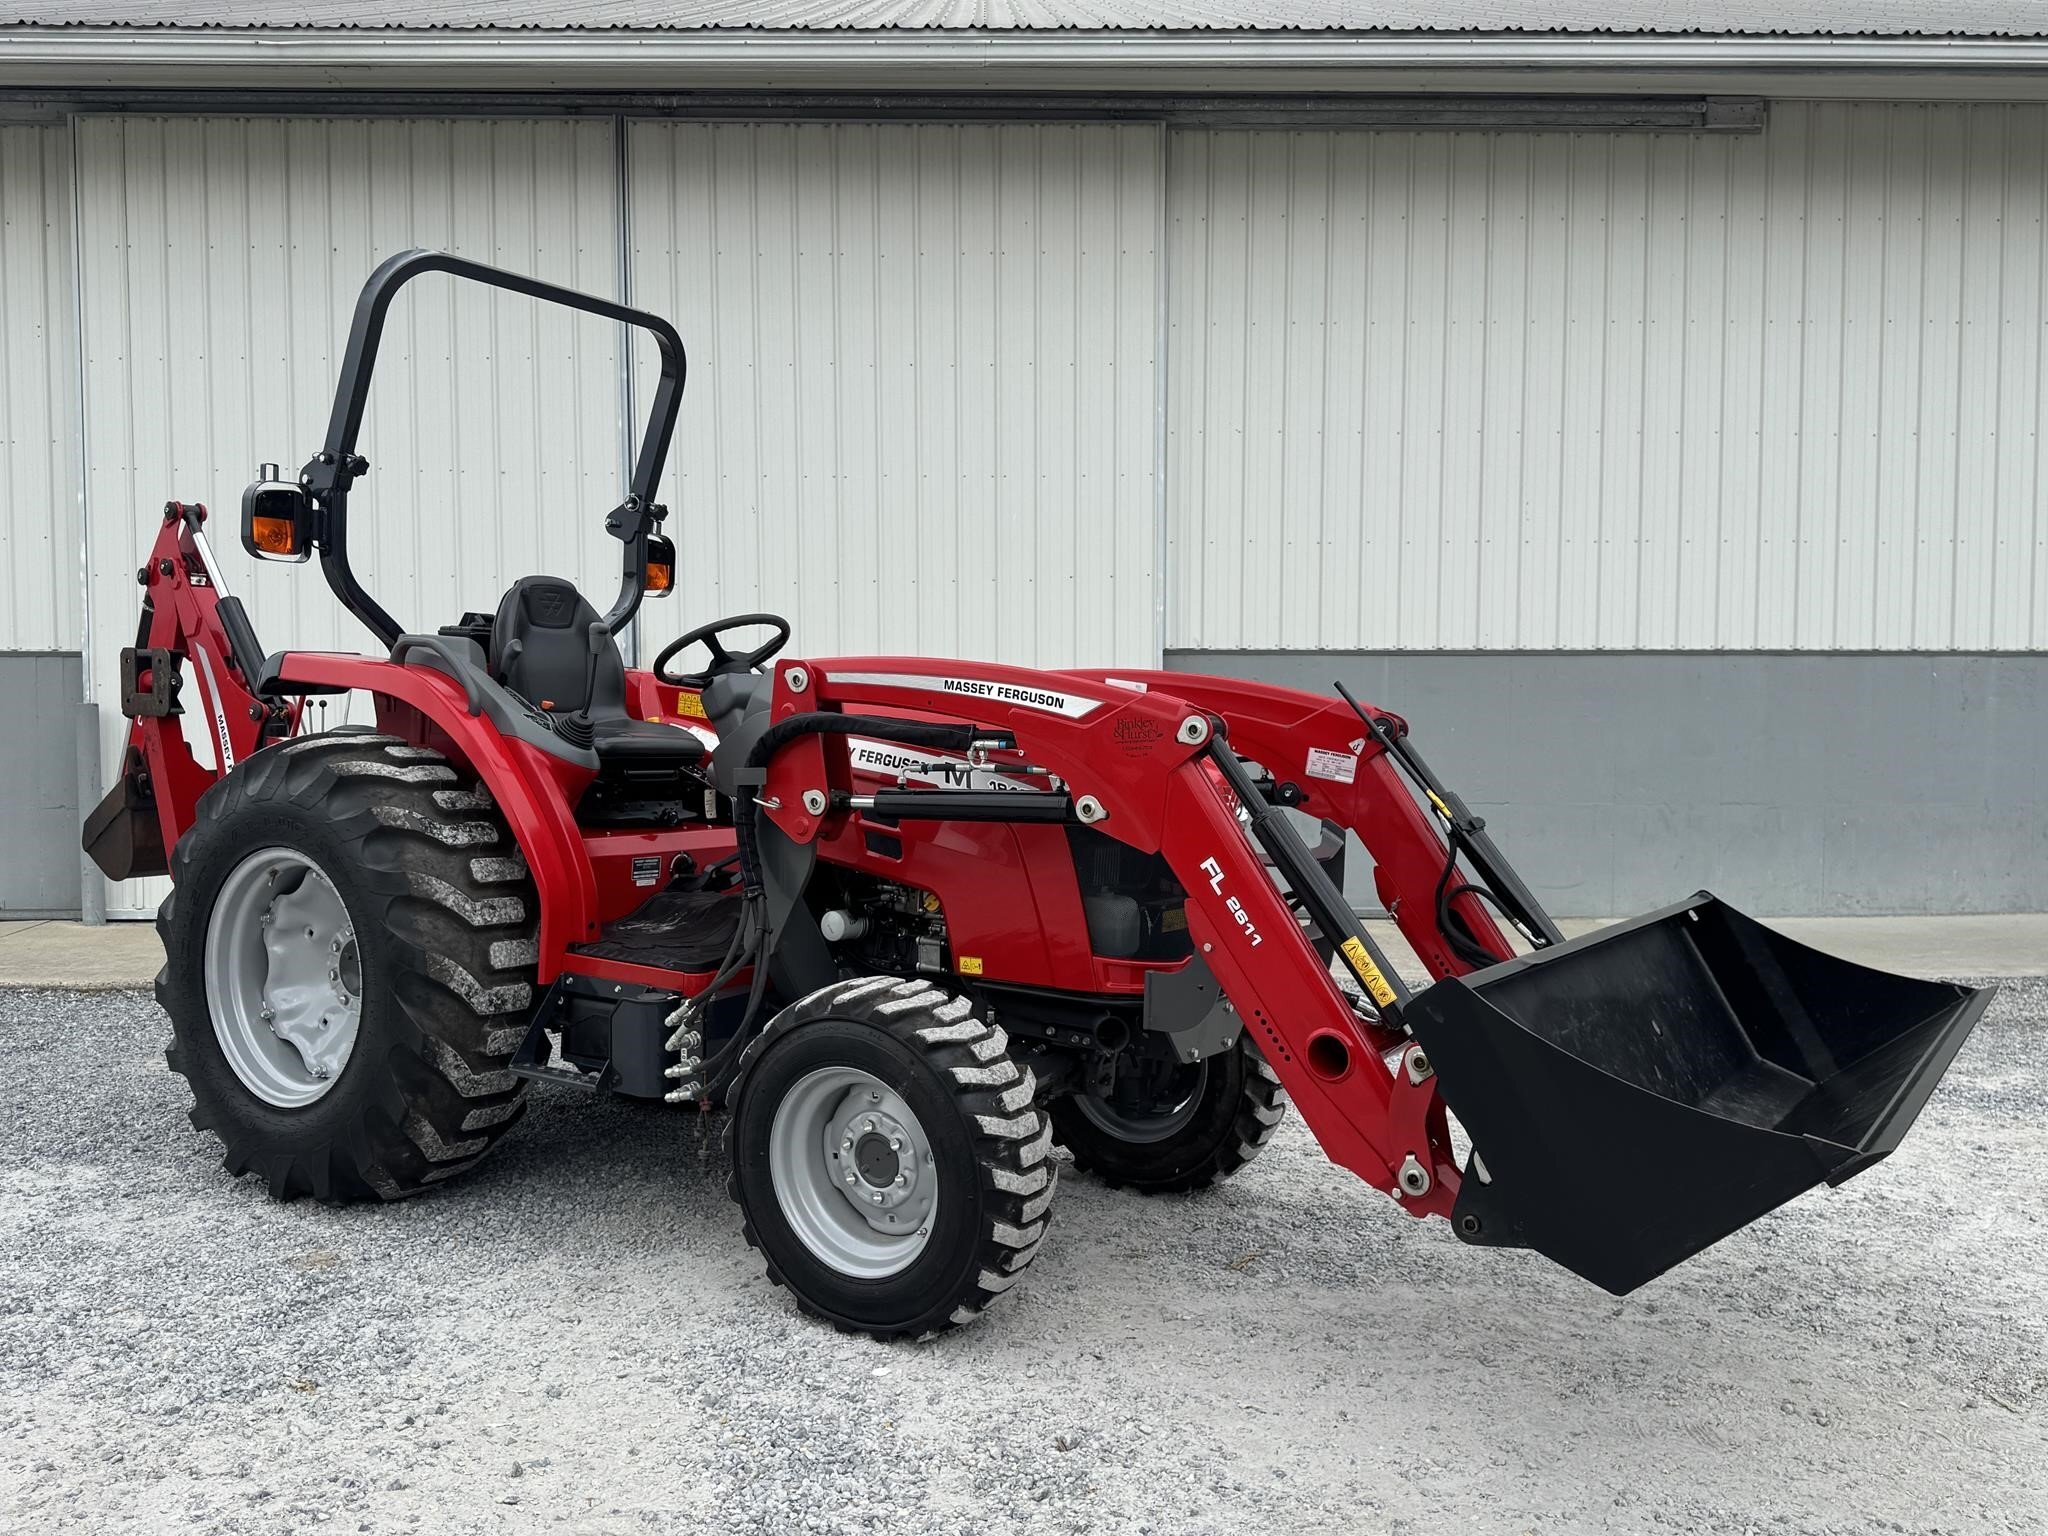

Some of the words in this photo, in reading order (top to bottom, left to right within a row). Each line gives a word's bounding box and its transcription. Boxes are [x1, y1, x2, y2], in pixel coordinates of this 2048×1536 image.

[944, 680, 994, 696] MASSEY
[997, 687, 1064, 709] FERGUSON
[218, 714, 231, 760] MASSEY
[1200, 856, 1225, 896] FL
[1225, 895, 1263, 947] 2611
